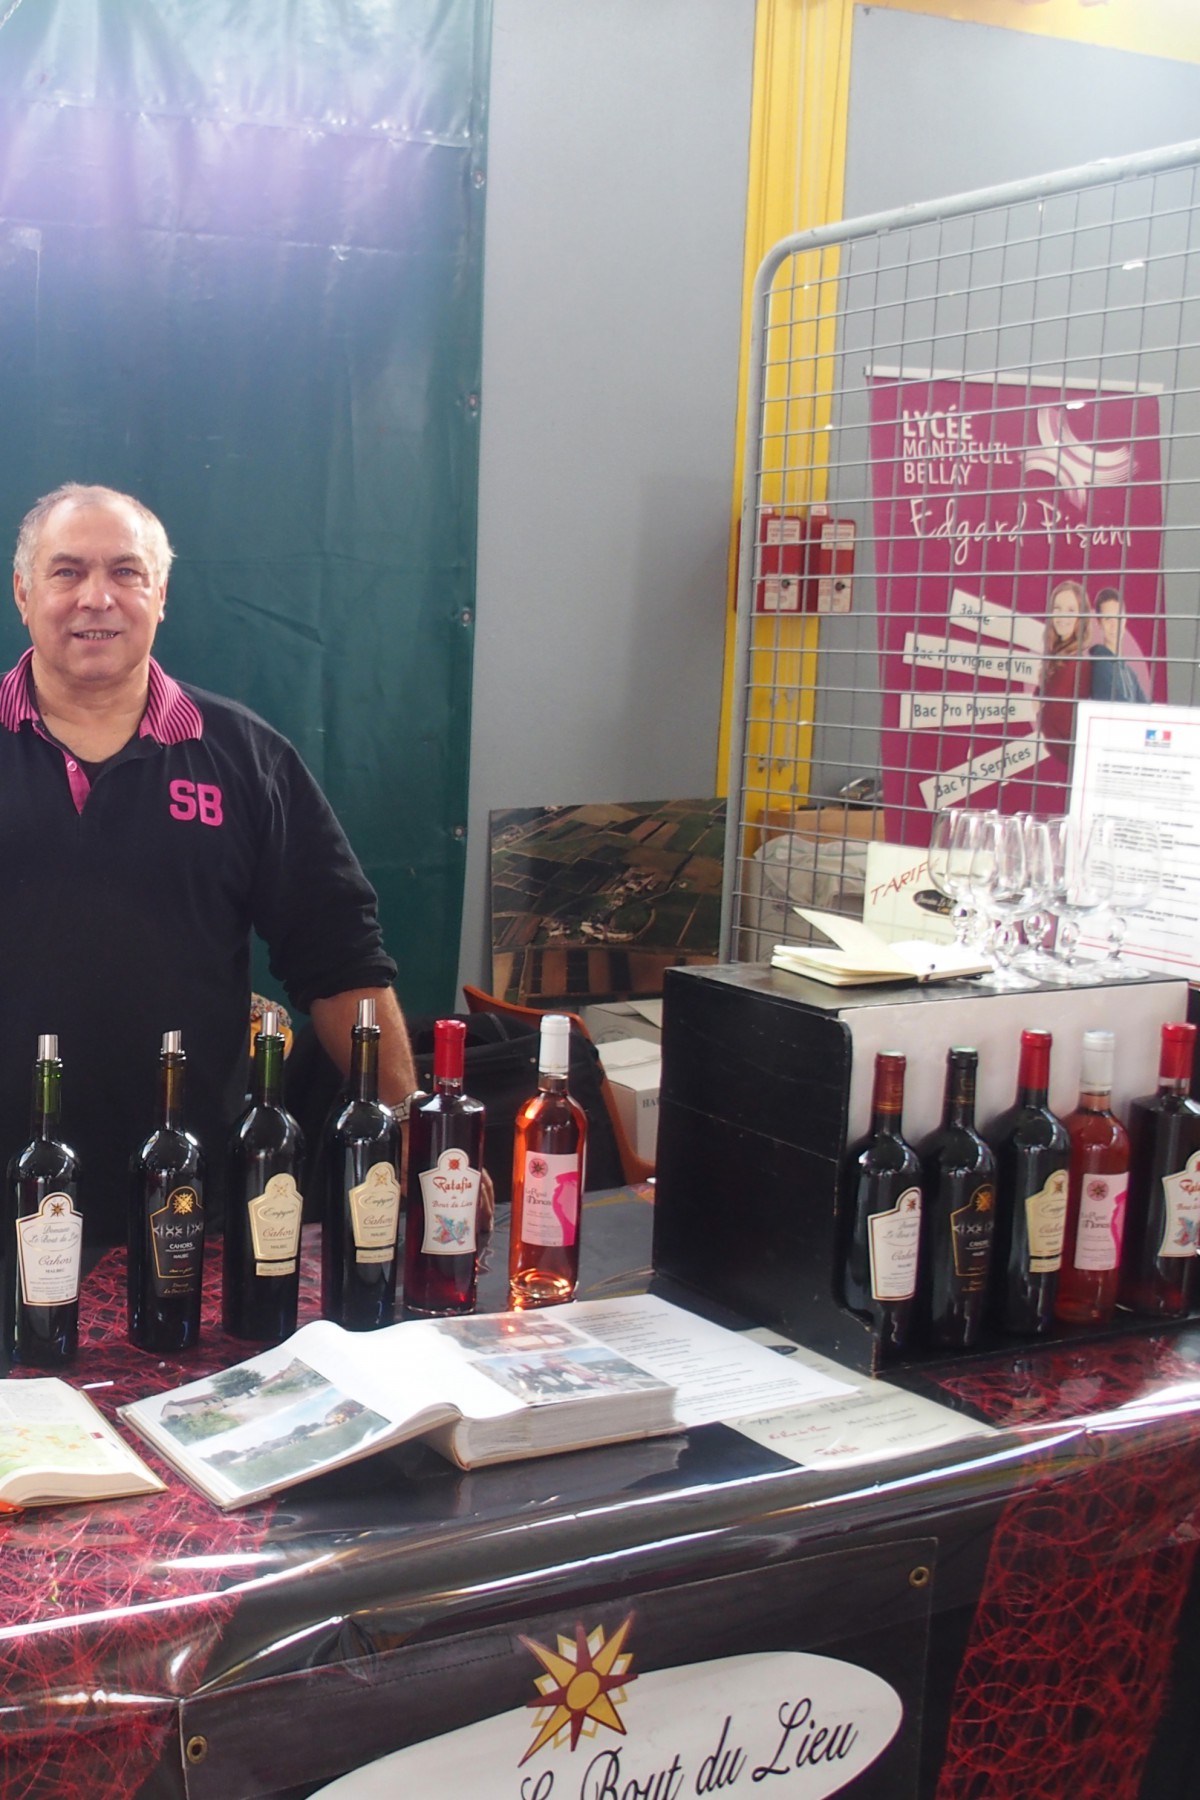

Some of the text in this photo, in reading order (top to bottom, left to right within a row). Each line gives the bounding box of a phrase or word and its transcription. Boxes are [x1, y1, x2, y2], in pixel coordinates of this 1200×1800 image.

[902, 404, 973, 440] LYCÉE
[903, 462, 972, 485] BELLAY
[960, 603, 990, 625] 3èe
[1015, 660, 1032, 674] Vin
[913, 703, 1016, 719] Bac Pro Paysage
[960, 771, 978, 787] Po
[980, 747, 1031, 777] Services
[169, 779, 223, 827] SB
[433, 1176, 472, 1194] Ratafia
[169, 1242, 193, 1250] CAHORS
[38, 1255, 72, 1266] Cahors
[698, 1716, 748, 1796] du
[752, 1698, 860, 1782] Lieu
